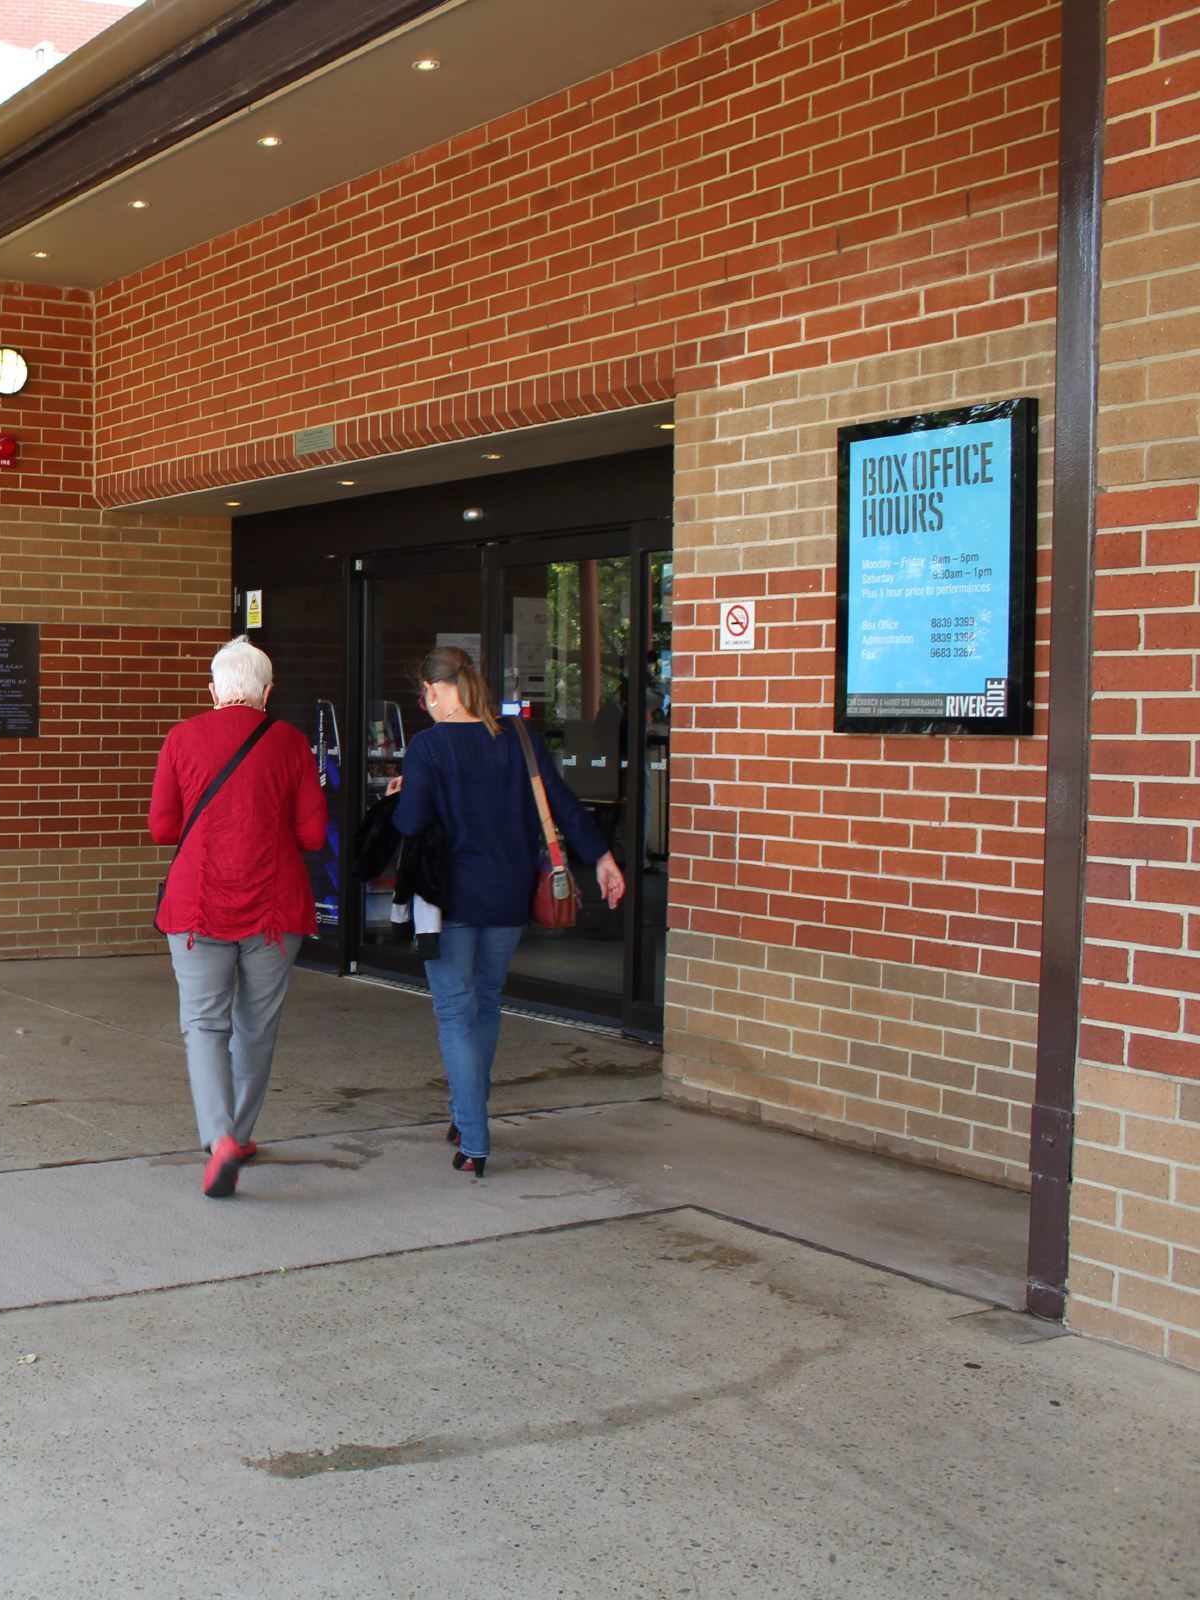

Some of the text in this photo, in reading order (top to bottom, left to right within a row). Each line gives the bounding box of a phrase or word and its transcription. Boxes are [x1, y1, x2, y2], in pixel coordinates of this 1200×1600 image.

[862, 442, 994, 496] BOX OFFICE
[862, 492, 944, 538] HOURS
[862, 559, 892, 570] Monday
[932, 554, 950, 565] 9am
[960, 552, 979, 564] 5pm
[862, 573, 895, 585] Saturday
[932, 568, 963, 580] 9:30am
[973, 567, 992, 579] 1pm
[862, 588, 878, 599] Plus
[886, 587, 903, 598] hour
[905, 585, 924, 598] prior
[927, 584, 934, 596] to
[936, 583, 992, 597] performances
[862, 620, 876, 630] Box
[931, 617, 952, 629] 8839
[931, 632, 952, 643] 8839
[930, 647, 951, 659] 9683
[945, 695, 986, 717] RIVER
